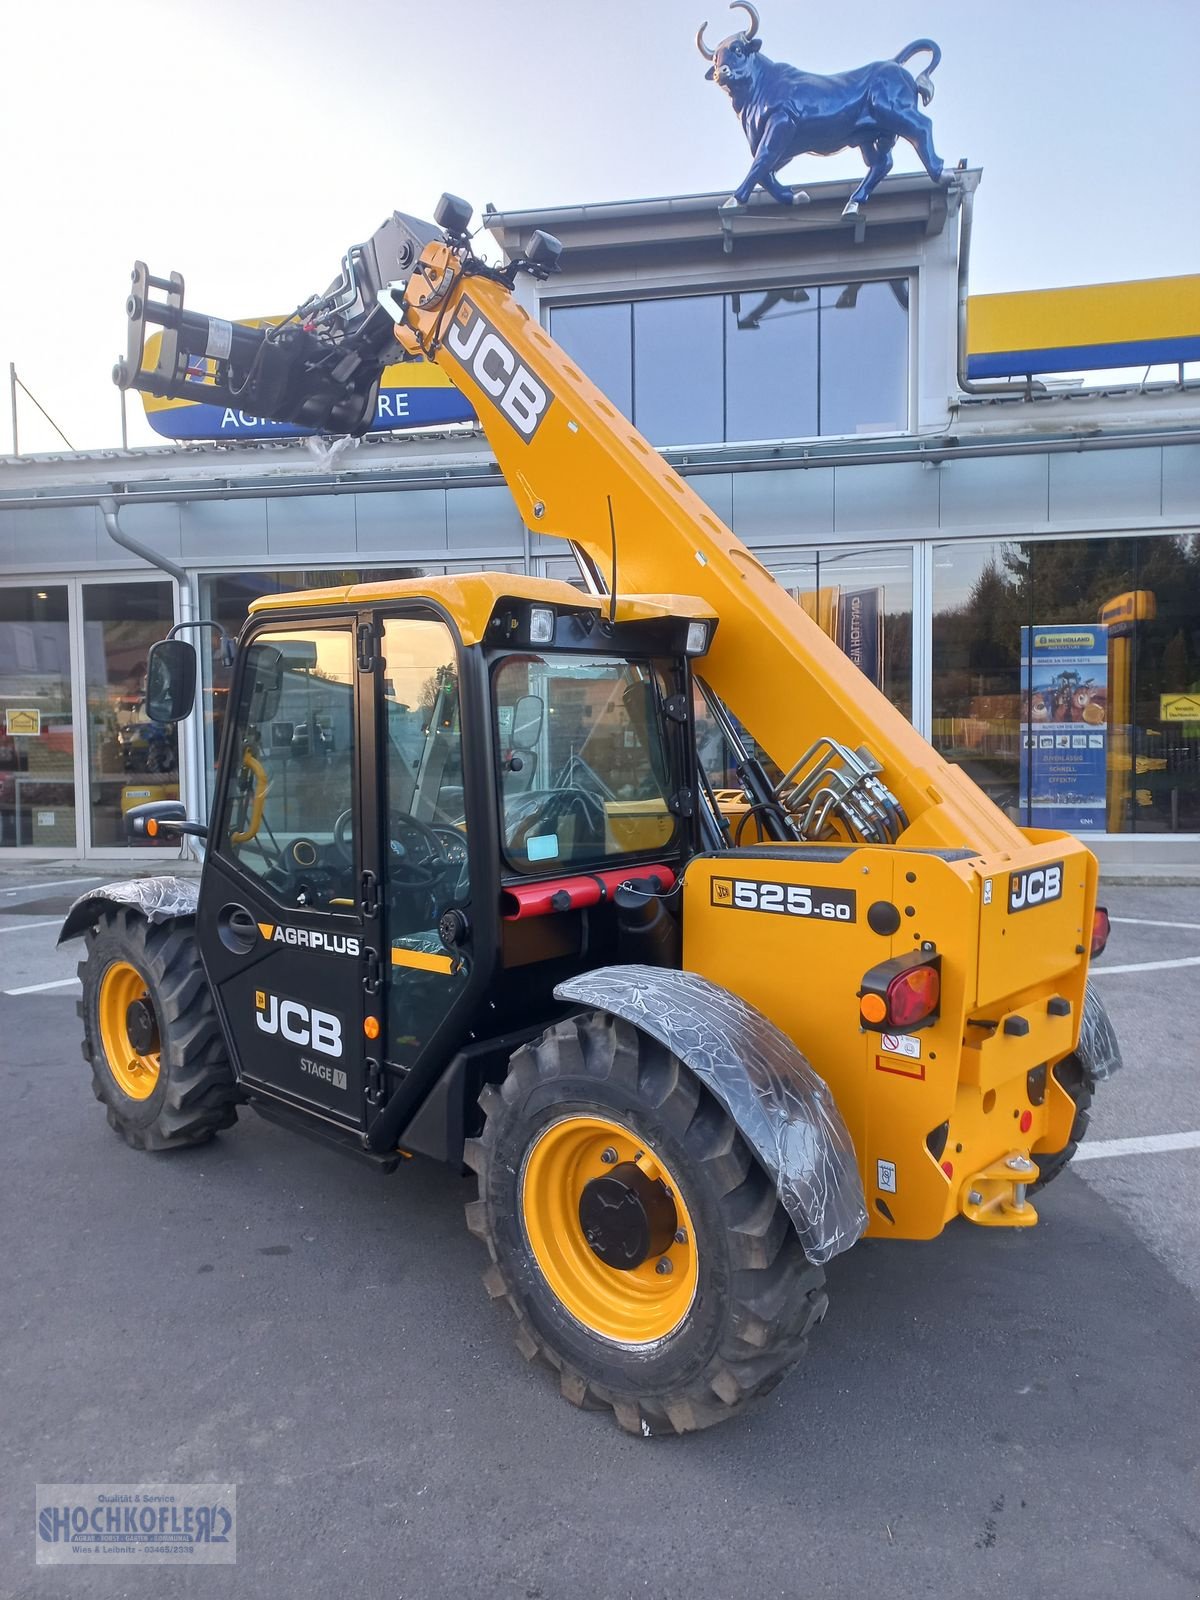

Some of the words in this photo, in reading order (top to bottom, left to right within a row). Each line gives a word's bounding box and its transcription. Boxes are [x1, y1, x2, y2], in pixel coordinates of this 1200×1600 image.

[448, 317, 547, 434] JCB
[734, 881, 851, 920] 525-60
[1011, 866, 1061, 908] JCB
[273, 925, 360, 956] AGRIPLUS
[256, 995, 343, 1058] JCB
[300, 1057, 332, 1082] STAGE
